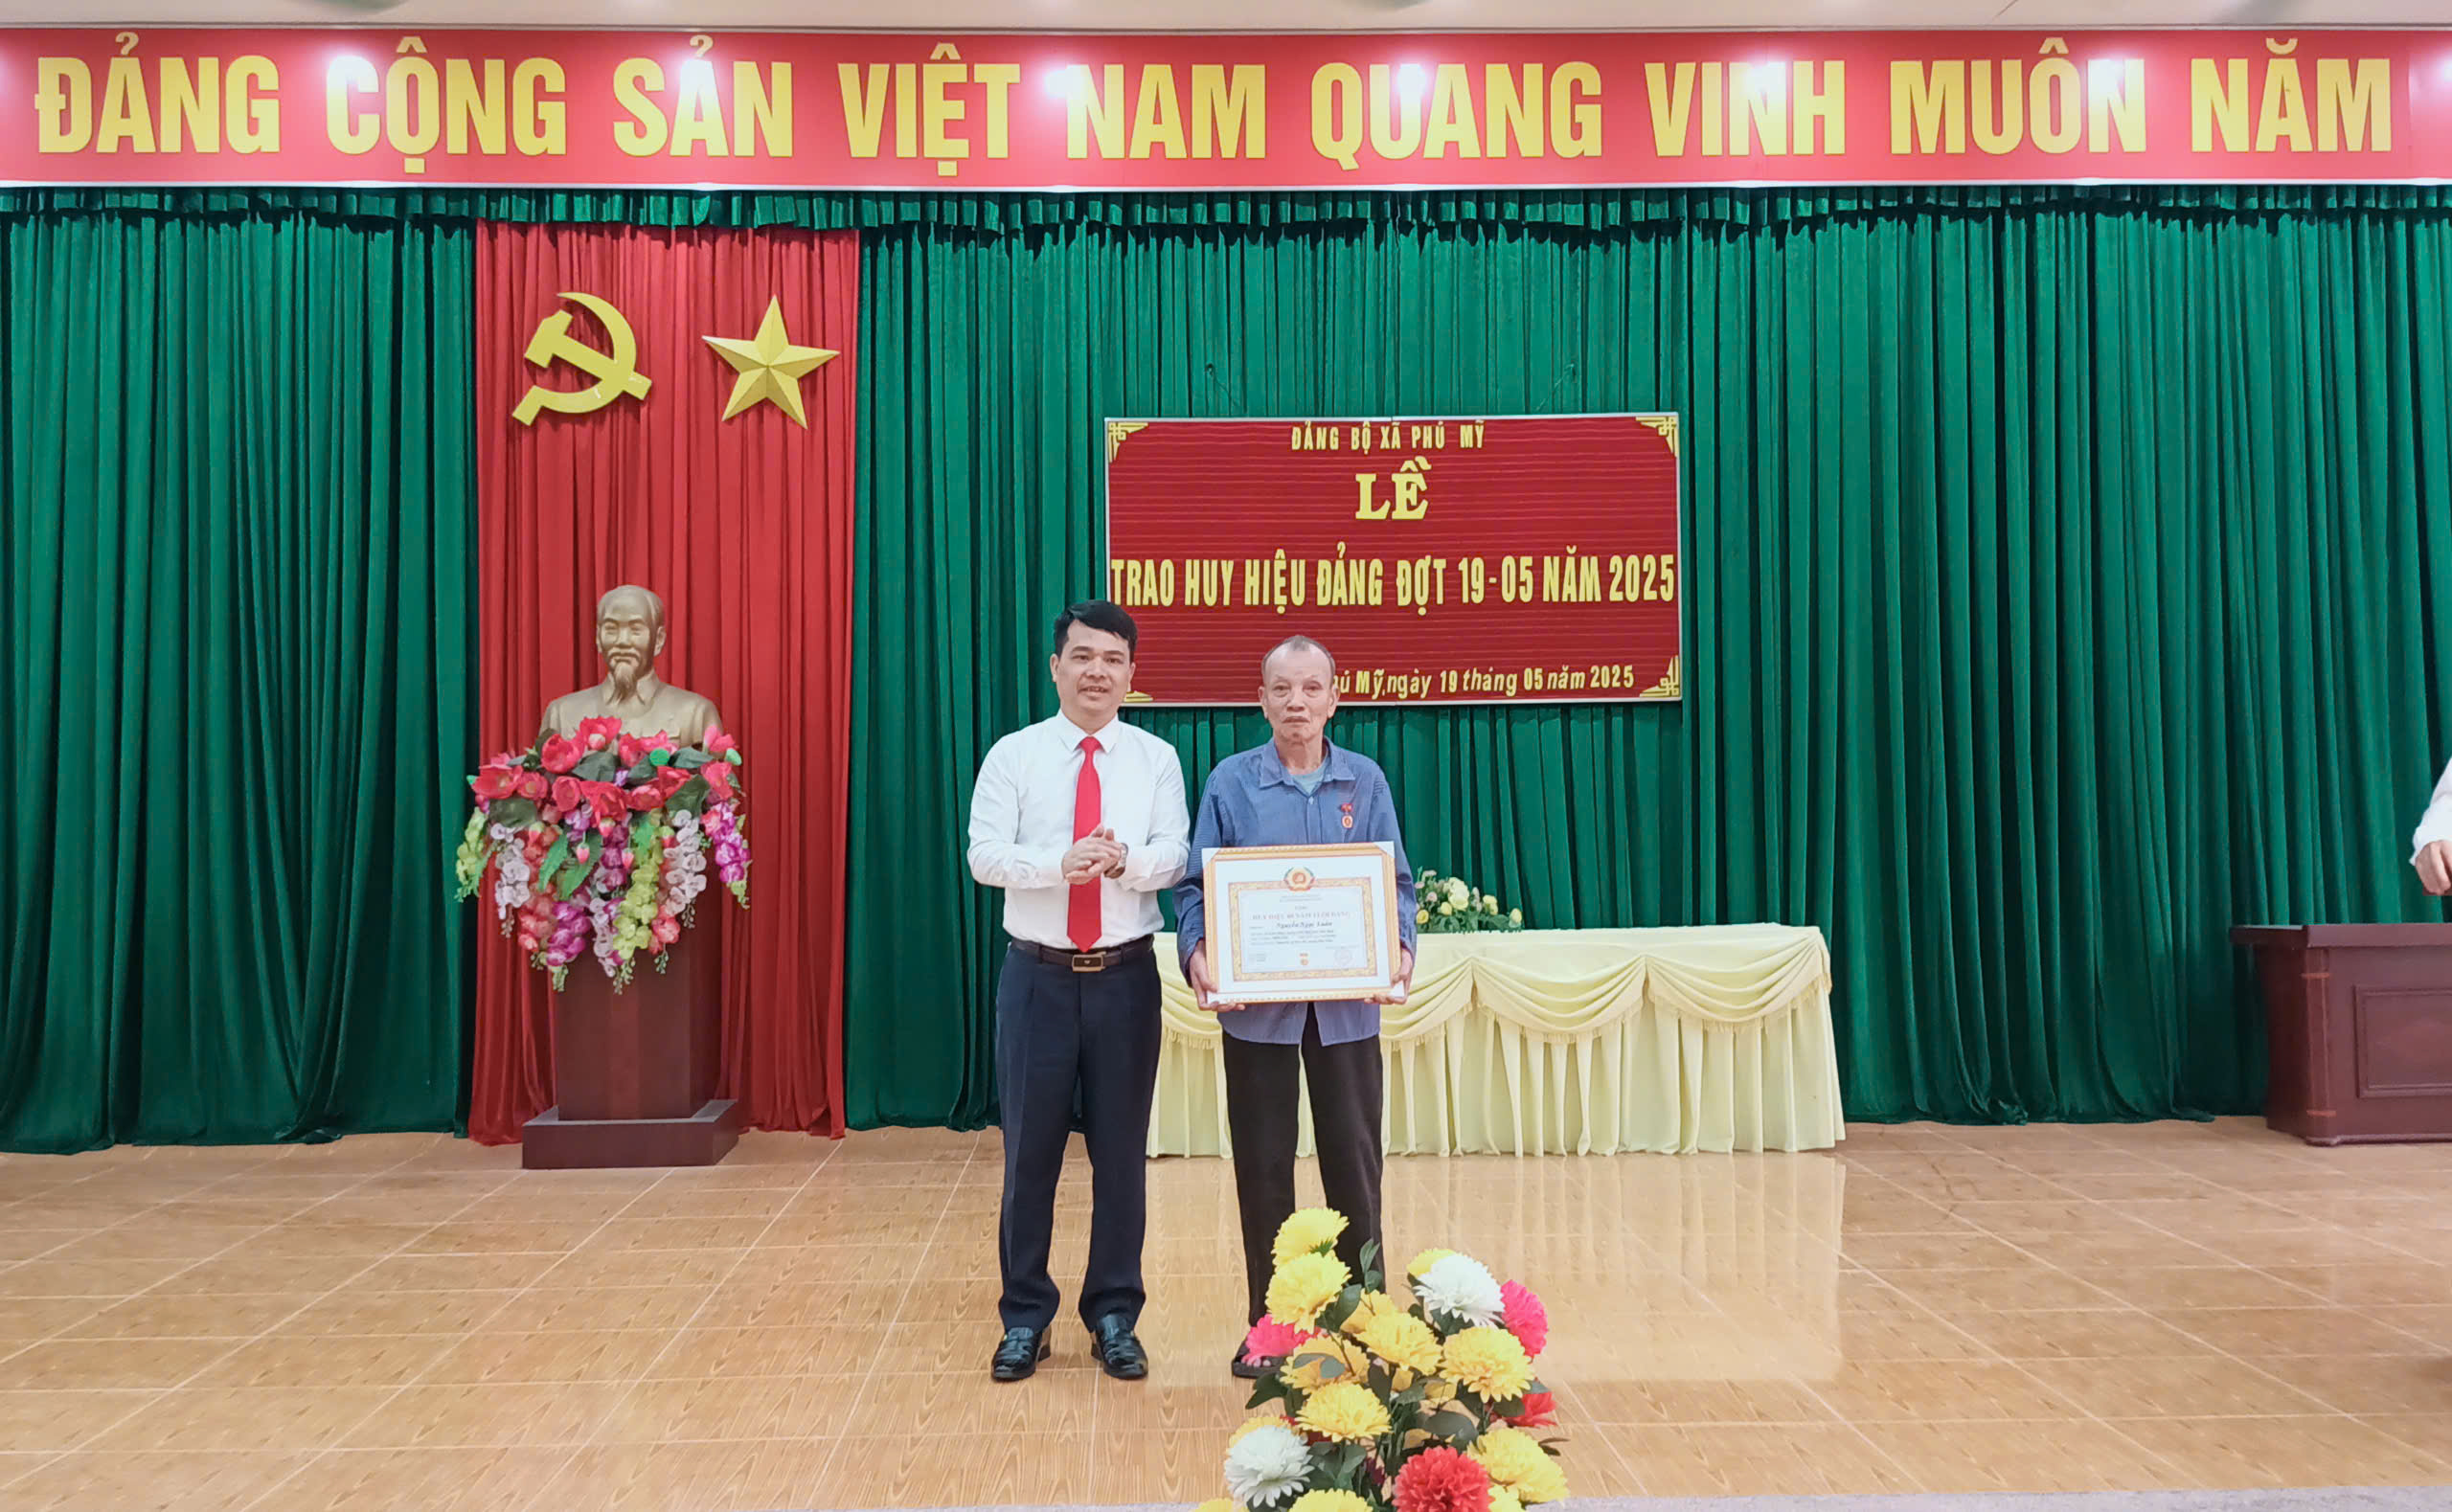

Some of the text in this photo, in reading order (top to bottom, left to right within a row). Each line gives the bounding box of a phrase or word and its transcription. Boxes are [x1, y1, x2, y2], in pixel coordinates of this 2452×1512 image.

[34, 32, 2392, 177] ĐẢNG CỘNG SẢN VIỆT NAM QUANG VINH MUÔN NĂM
[1291, 419, 1485, 455] ĐẢNG BỘ XÃ PHÚ MỸ
[1110, 558, 1174, 606] TRAO
[1184, 558, 1234, 606] HUY
[1244, 548, 1305, 614] HIỆU
[1316, 541, 1383, 606] ĐẢNG
[1396, 554, 1446, 616] ĐỢT
[1543, 545, 1601, 602] NĂM
[1609, 553, 1674, 602] 2025
[1440, 669, 1458, 693] 19
[1463, 666, 1518, 697] tháng
[1524, 667, 1544, 691] 05
[1547, 664, 1586, 690] năm
[1590, 664, 1634, 688] 2025
